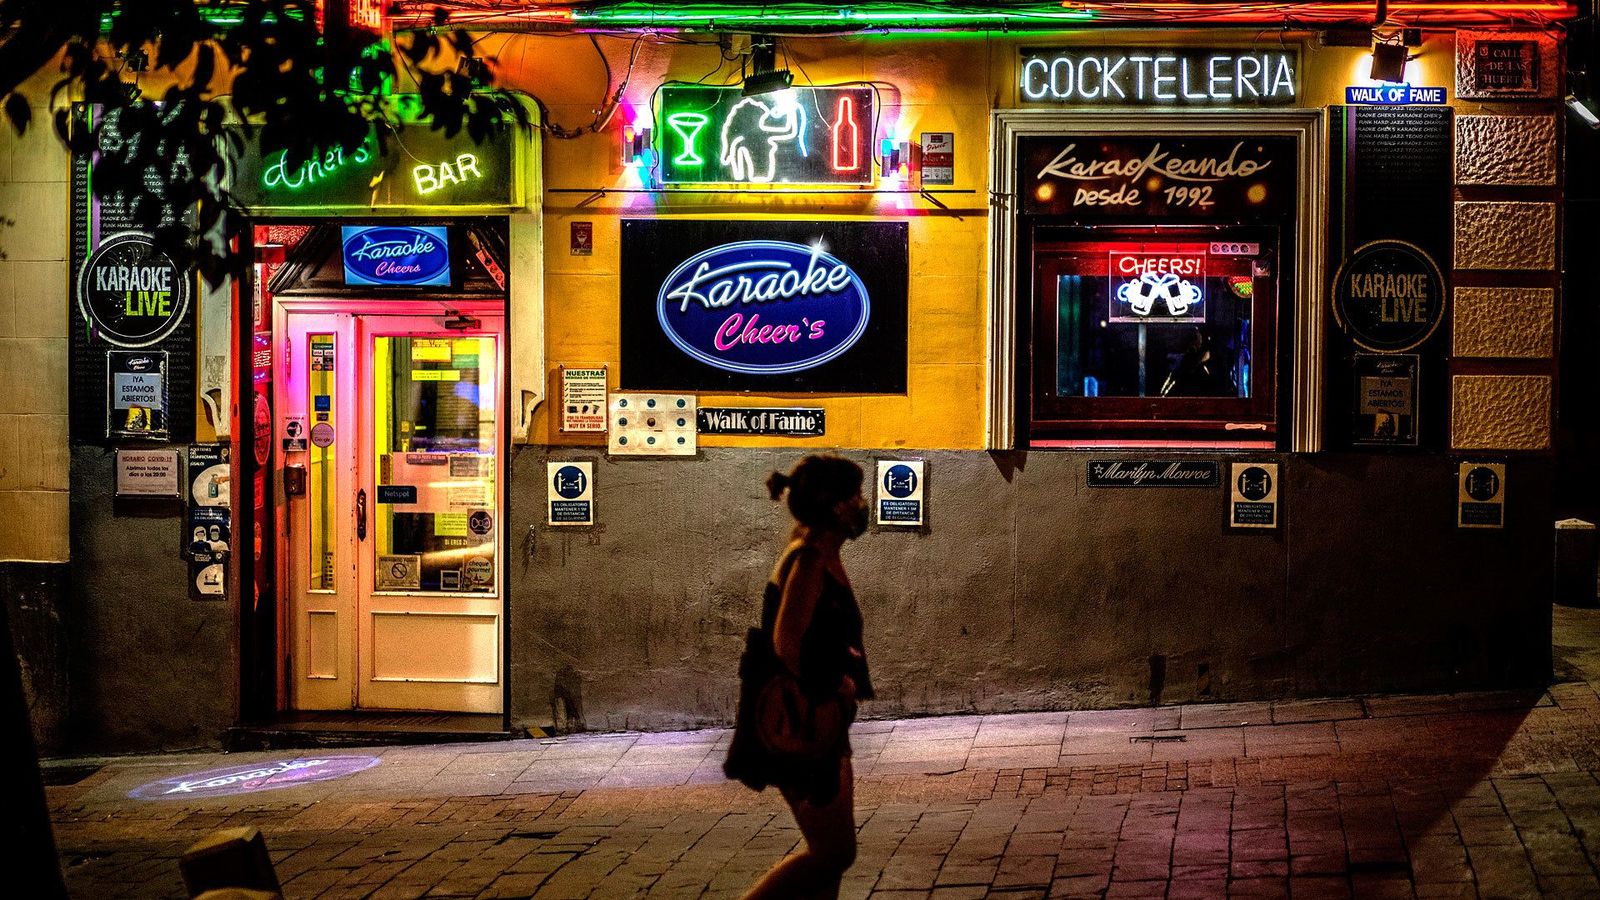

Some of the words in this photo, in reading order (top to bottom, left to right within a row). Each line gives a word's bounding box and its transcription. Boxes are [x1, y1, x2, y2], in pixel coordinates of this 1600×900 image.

[1023, 55, 1296, 100] COCKTELERIA
[1490, 62, 1504, 70] DE
[1351, 88, 1384, 102] WALK
[1388, 88, 1405, 102] OF
[1410, 89, 1440, 102] FAME
[413, 154, 484, 195] BAR
[1164, 186, 1215, 207] 1992
[351, 236, 435, 261] Karaoke
[1120, 256, 1200, 275] CHEERS!
[96, 266, 172, 292] KARAOKE
[667, 249, 851, 312] Karaoke
[1350, 273, 1428, 298] KARAOKE
[126, 291, 170, 316] LIVE
[1381, 298, 1427, 323] LIVE
[705, 412, 748, 430] Walk
[751, 412, 766, 430] of
[770, 412, 816, 430] Fame
[1098, 462, 1156, 485] Marilyn
[1157, 462, 1211, 480] Monroe
